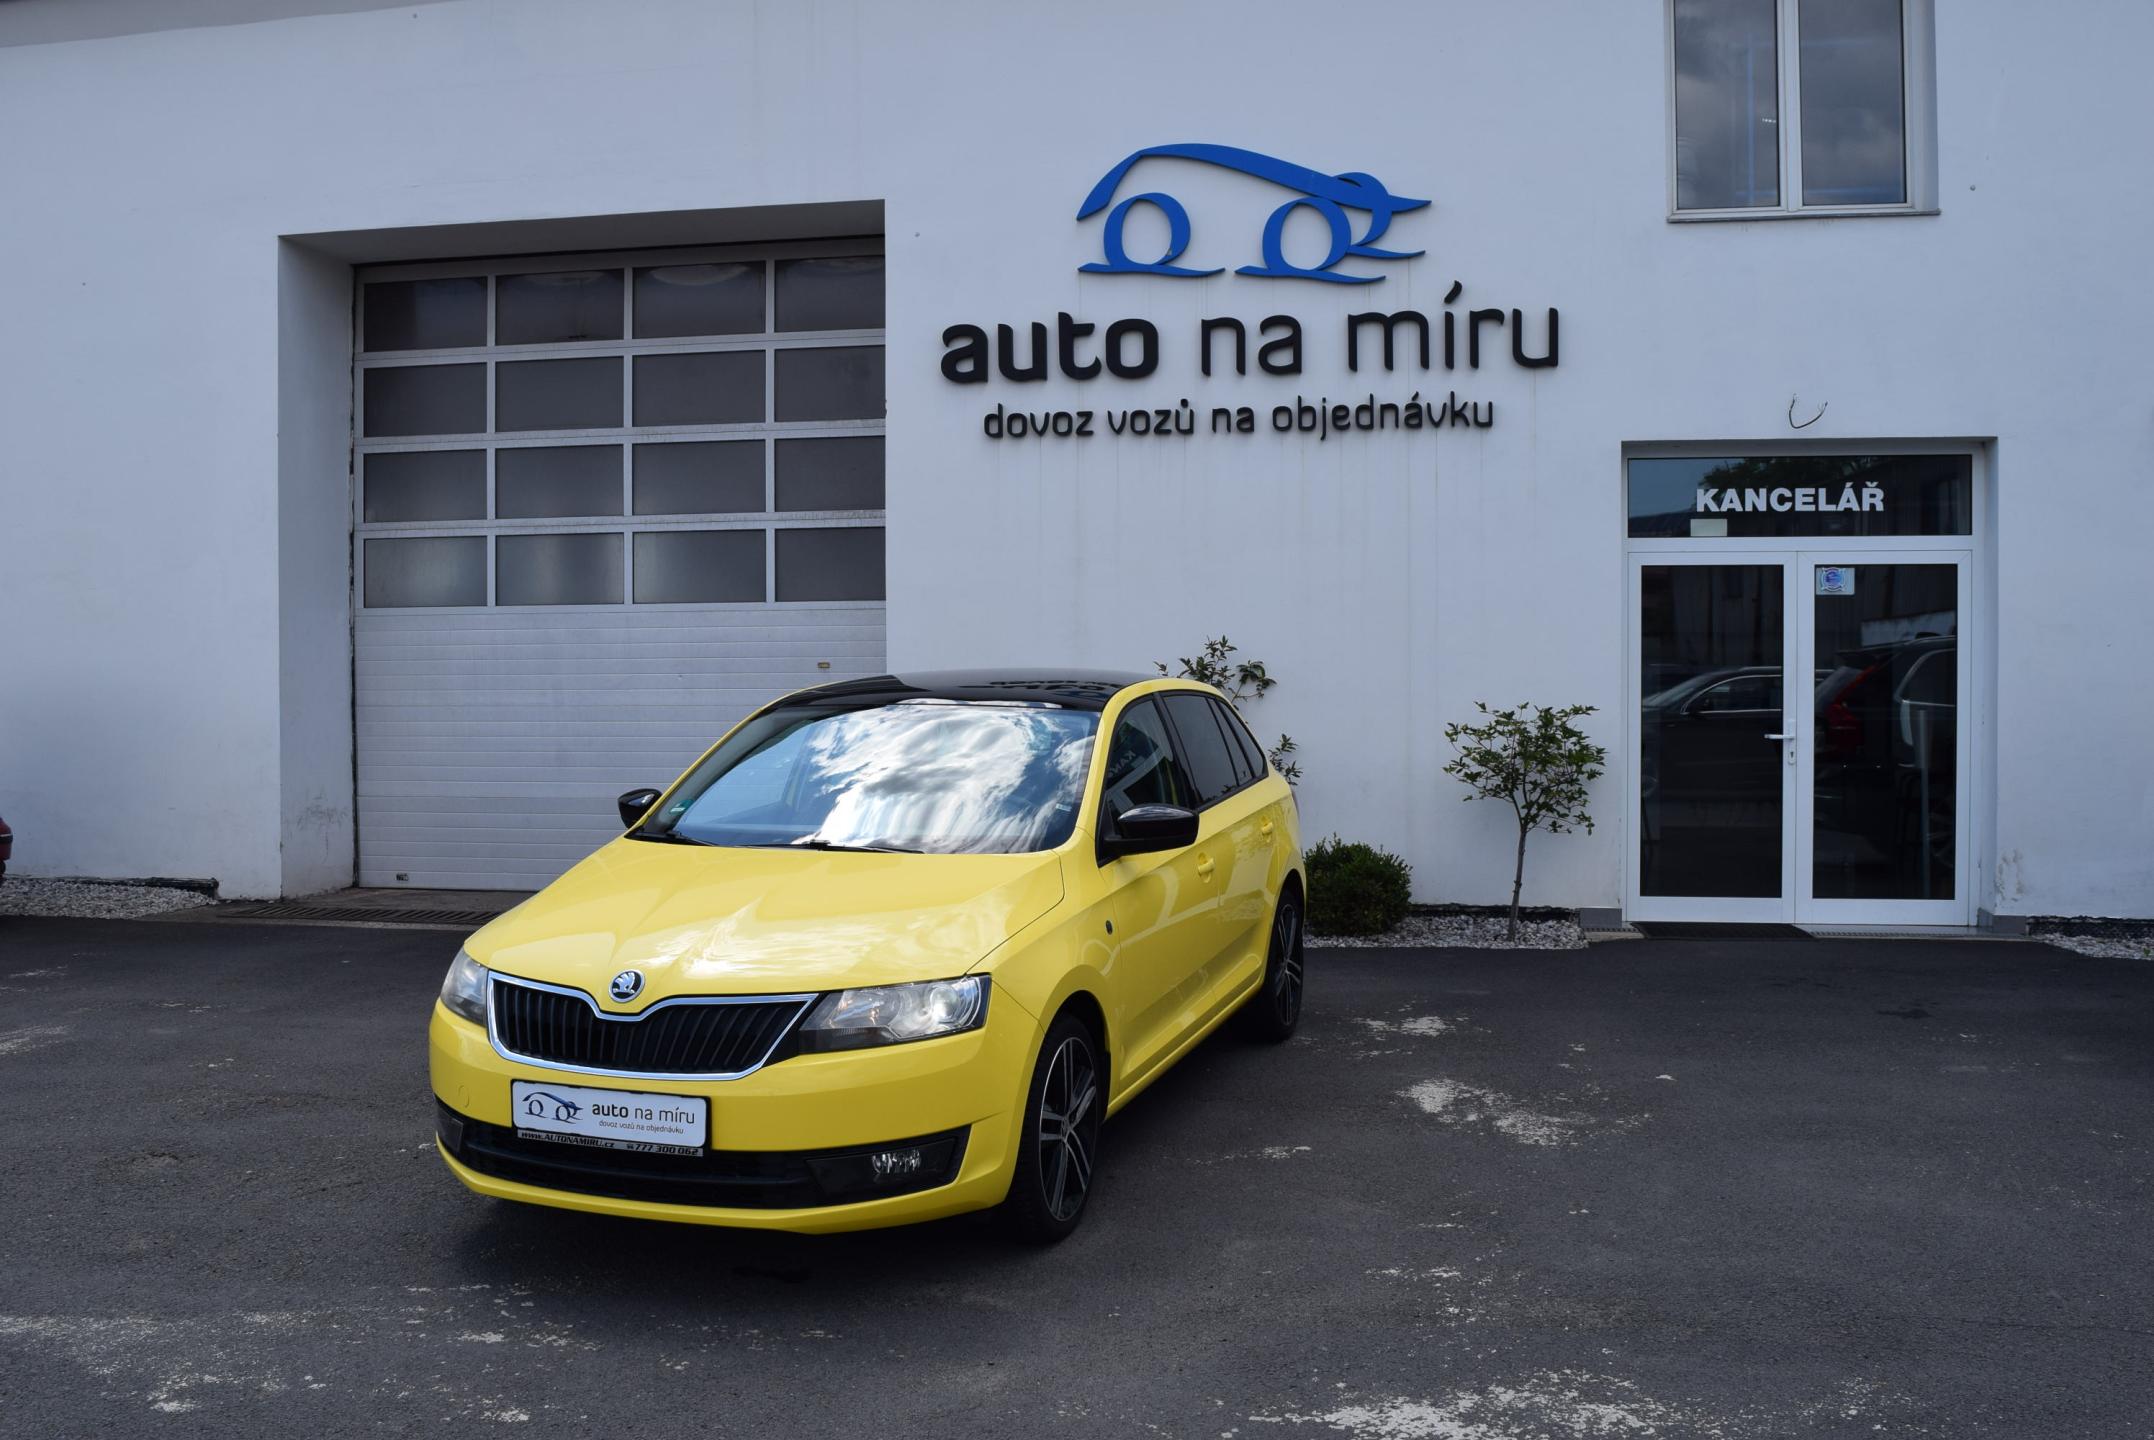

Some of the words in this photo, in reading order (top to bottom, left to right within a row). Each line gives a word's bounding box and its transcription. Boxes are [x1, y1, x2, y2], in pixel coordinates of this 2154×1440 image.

[940, 311, 1159, 383] auto
[1201, 314, 1302, 376] na
[1347, 280, 1559, 372] míru
[984, 404, 1094, 439] dovoz
[1107, 398, 1194, 436] vozů
[1212, 405, 1255, 433] na
[1272, 391, 1493, 441] objednávku
[1696, 481, 1885, 513] KANCELÁŘ
[592, 1103, 629, 1118] auto
[634, 1107, 653, 1120] na
[659, 1106, 695, 1124] míru
[599, 1120, 618, 1128] dovoz
[635, 1123, 645, 1131] na
